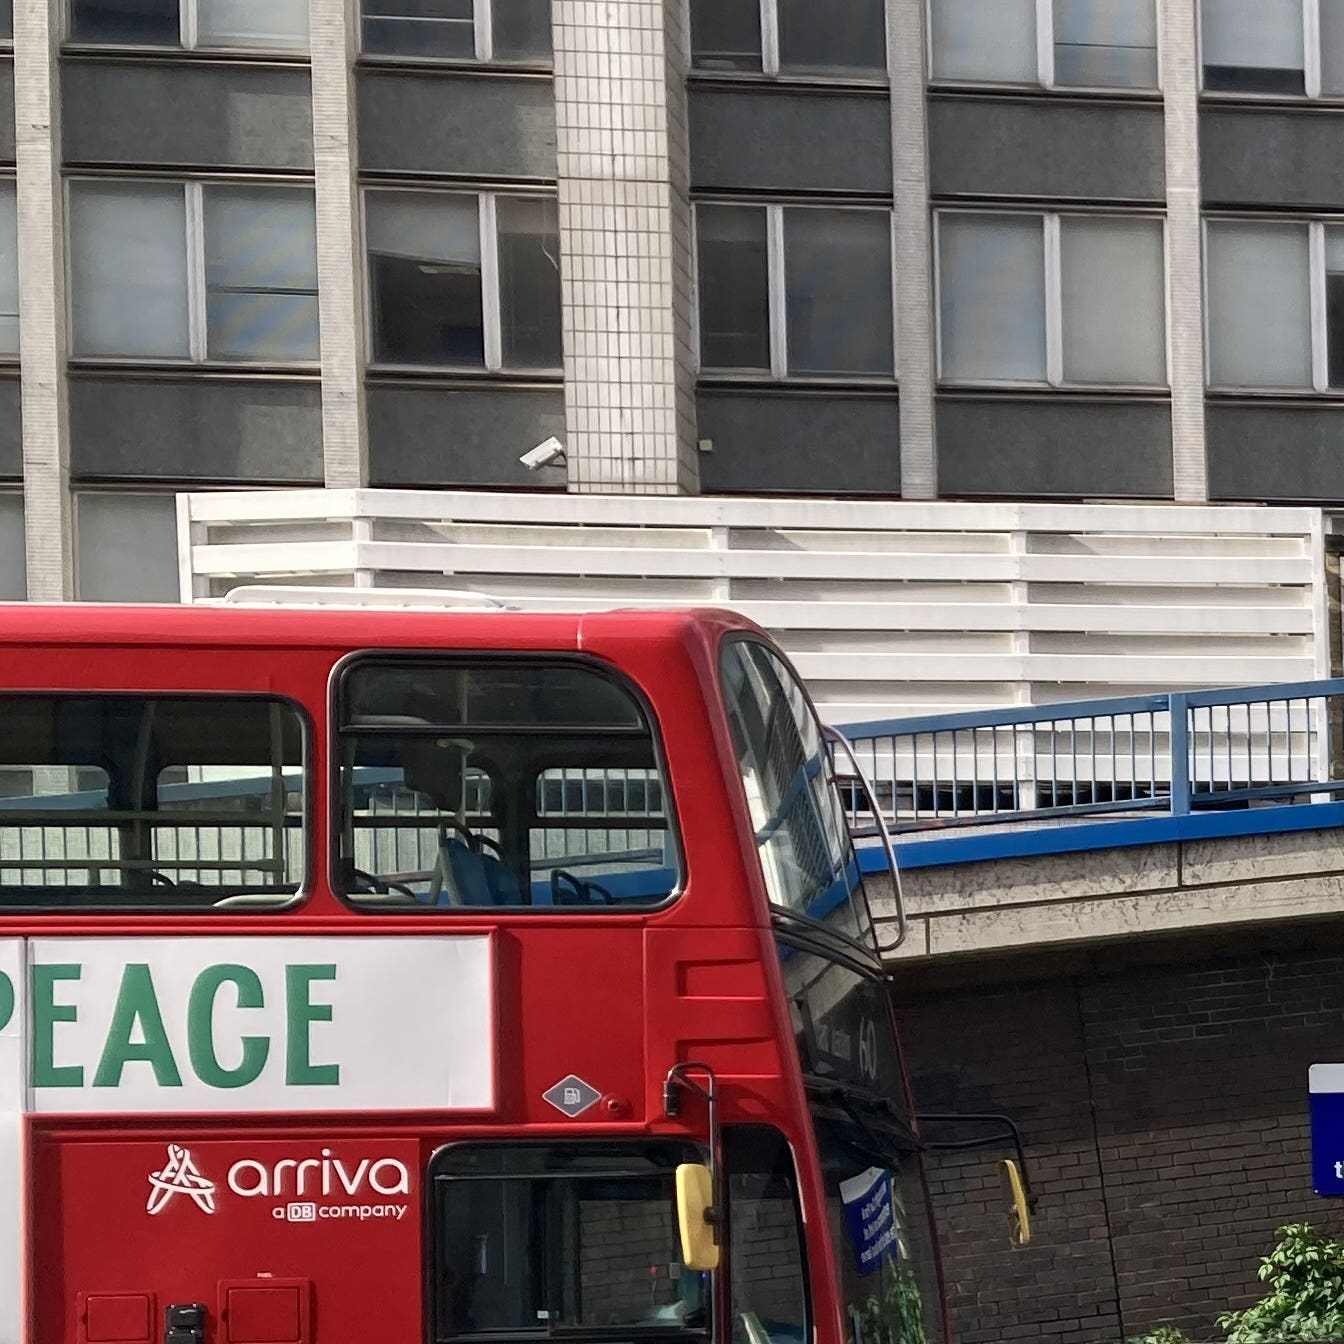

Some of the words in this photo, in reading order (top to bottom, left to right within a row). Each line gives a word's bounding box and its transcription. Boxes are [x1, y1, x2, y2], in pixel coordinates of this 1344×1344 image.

[0, 963, 340, 1089] EACE
[227, 1148, 409, 1197] arriva
[272, 1207, 285, 1219] a
[289, 1204, 315, 1220] DB
[318, 1204, 407, 1221] company
